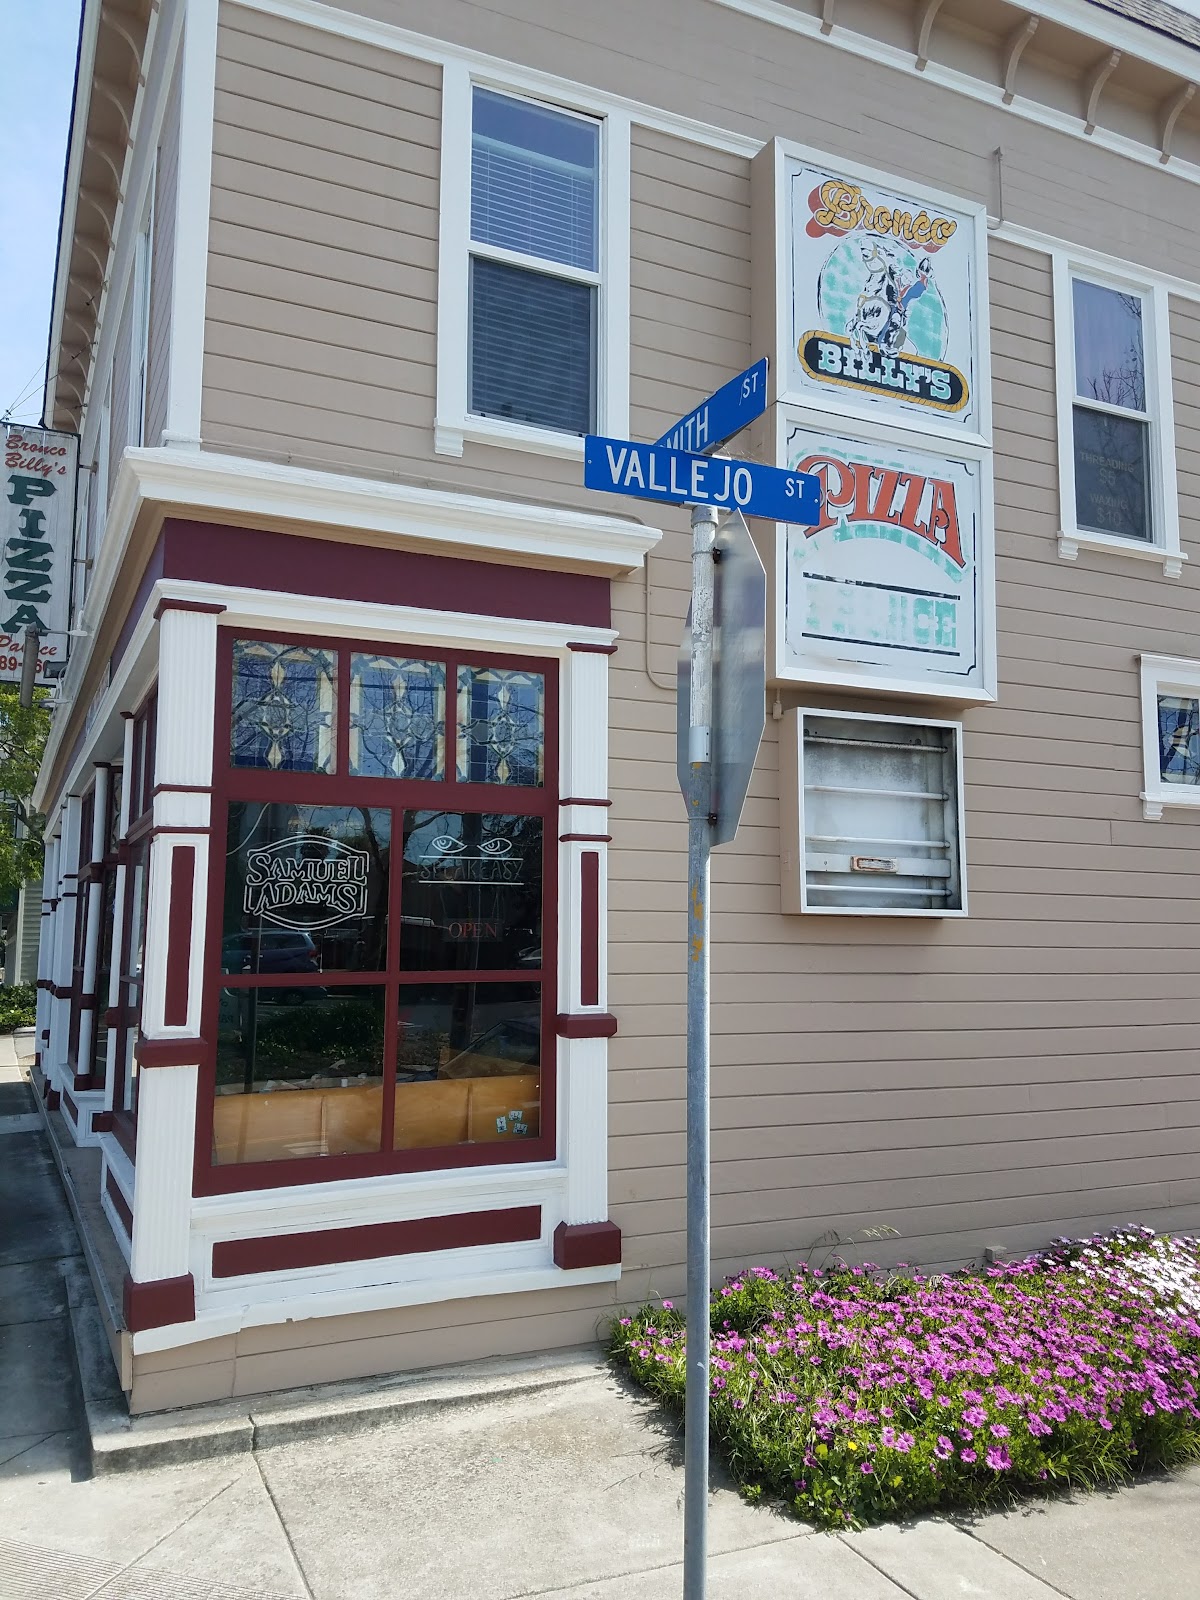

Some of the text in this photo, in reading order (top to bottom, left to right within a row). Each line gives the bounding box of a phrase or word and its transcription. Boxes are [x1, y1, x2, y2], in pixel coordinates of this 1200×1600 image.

[815, 180, 957, 248] Bronco
[818, 341, 952, 400] BILLY'S
[660, 371, 759, 451] MITH ST
[5, 434, 67, 456] Bronco
[5, 452, 67, 478] Billy's
[1080, 451, 1135, 473] THREADING
[605, 445, 805, 506] VALLEJO ST
[796, 454, 966, 568] PIZZA
[1, 474, 58, 637] PIZZA
[246, 852, 367, 886] SAMUEL
[252, 882, 358, 915] ADAMS
[448, 921, 498, 938] OPEN
